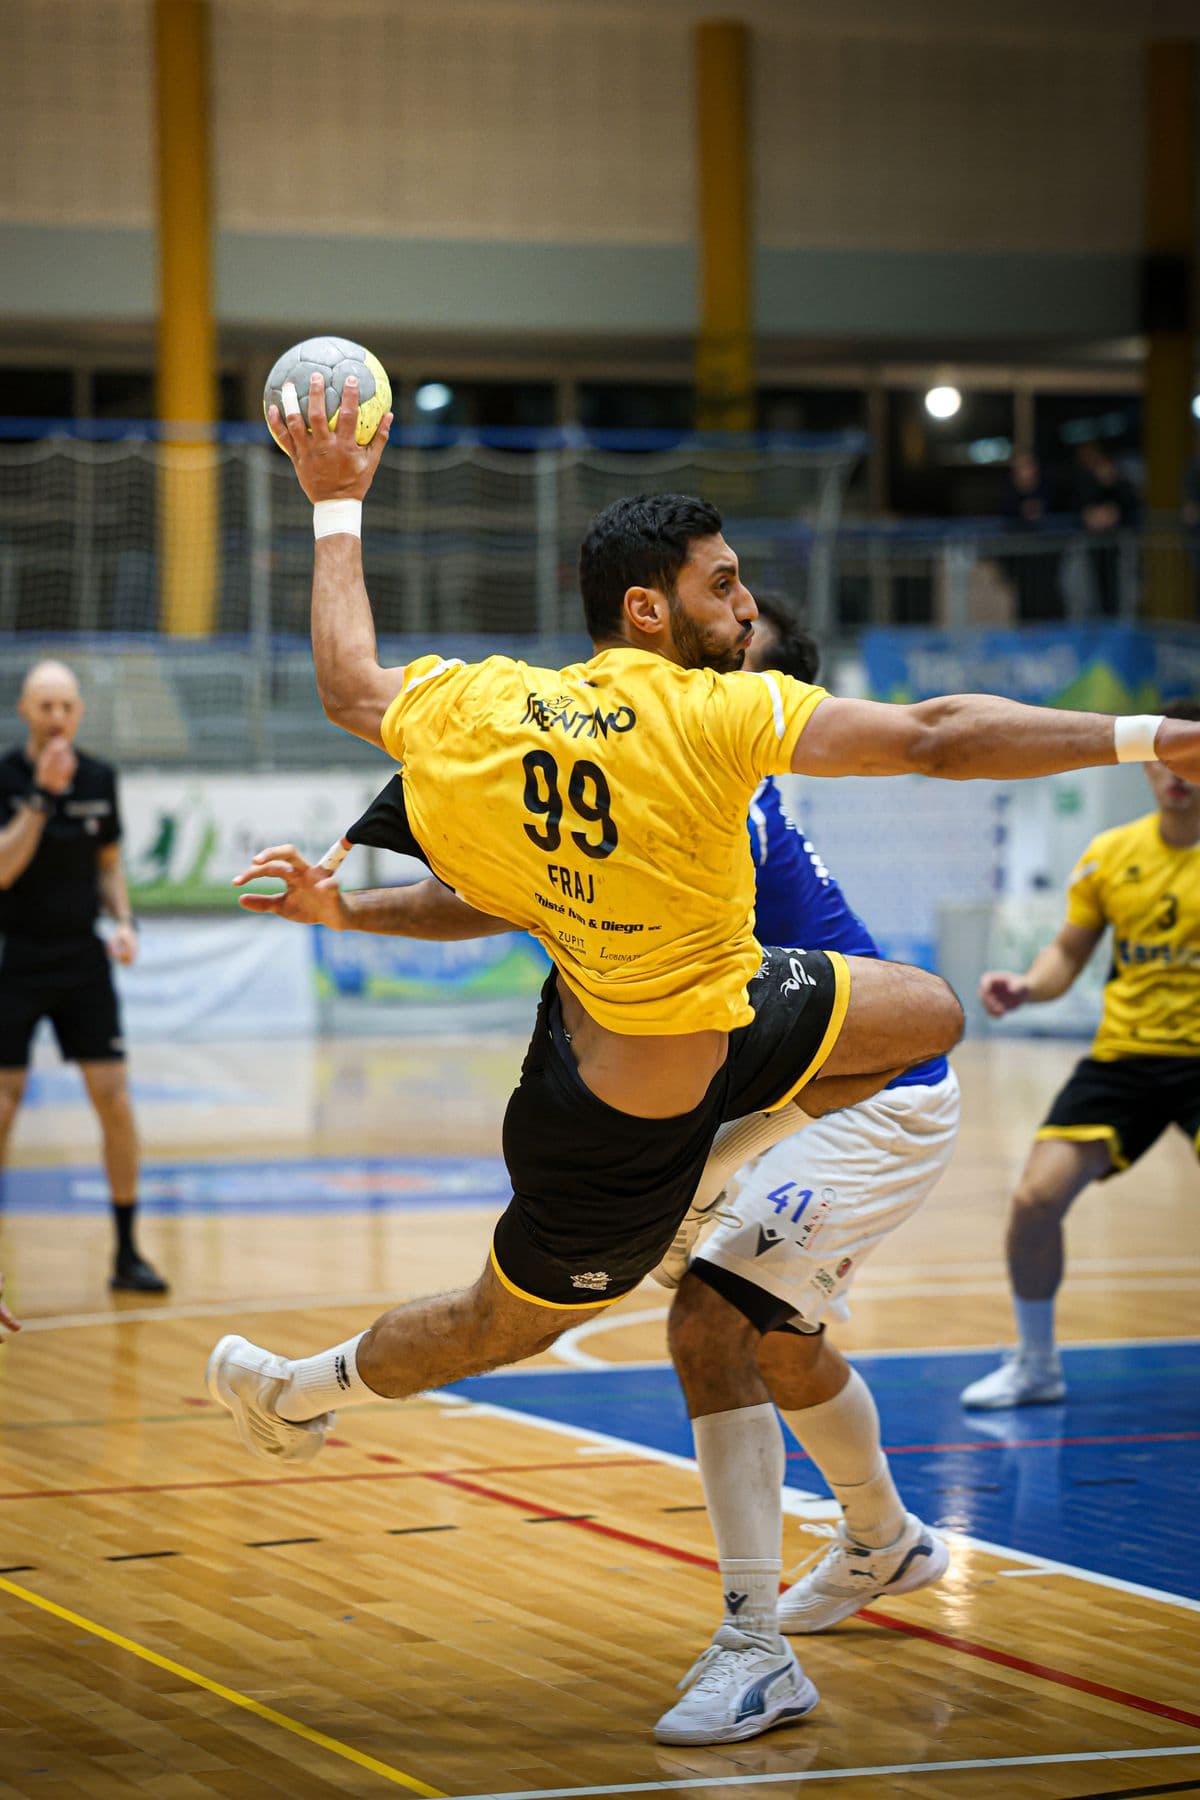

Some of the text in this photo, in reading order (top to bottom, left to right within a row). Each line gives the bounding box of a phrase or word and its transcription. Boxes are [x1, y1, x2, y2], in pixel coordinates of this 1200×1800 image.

[522, 749, 619, 859] 99
[547, 864, 595, 904] FRAJ
[558, 931, 585, 948] ZUPIT
[588, 919, 598, 929] &
[601, 920, 645, 934] Diego
[766, 1181, 814, 1224] 41
